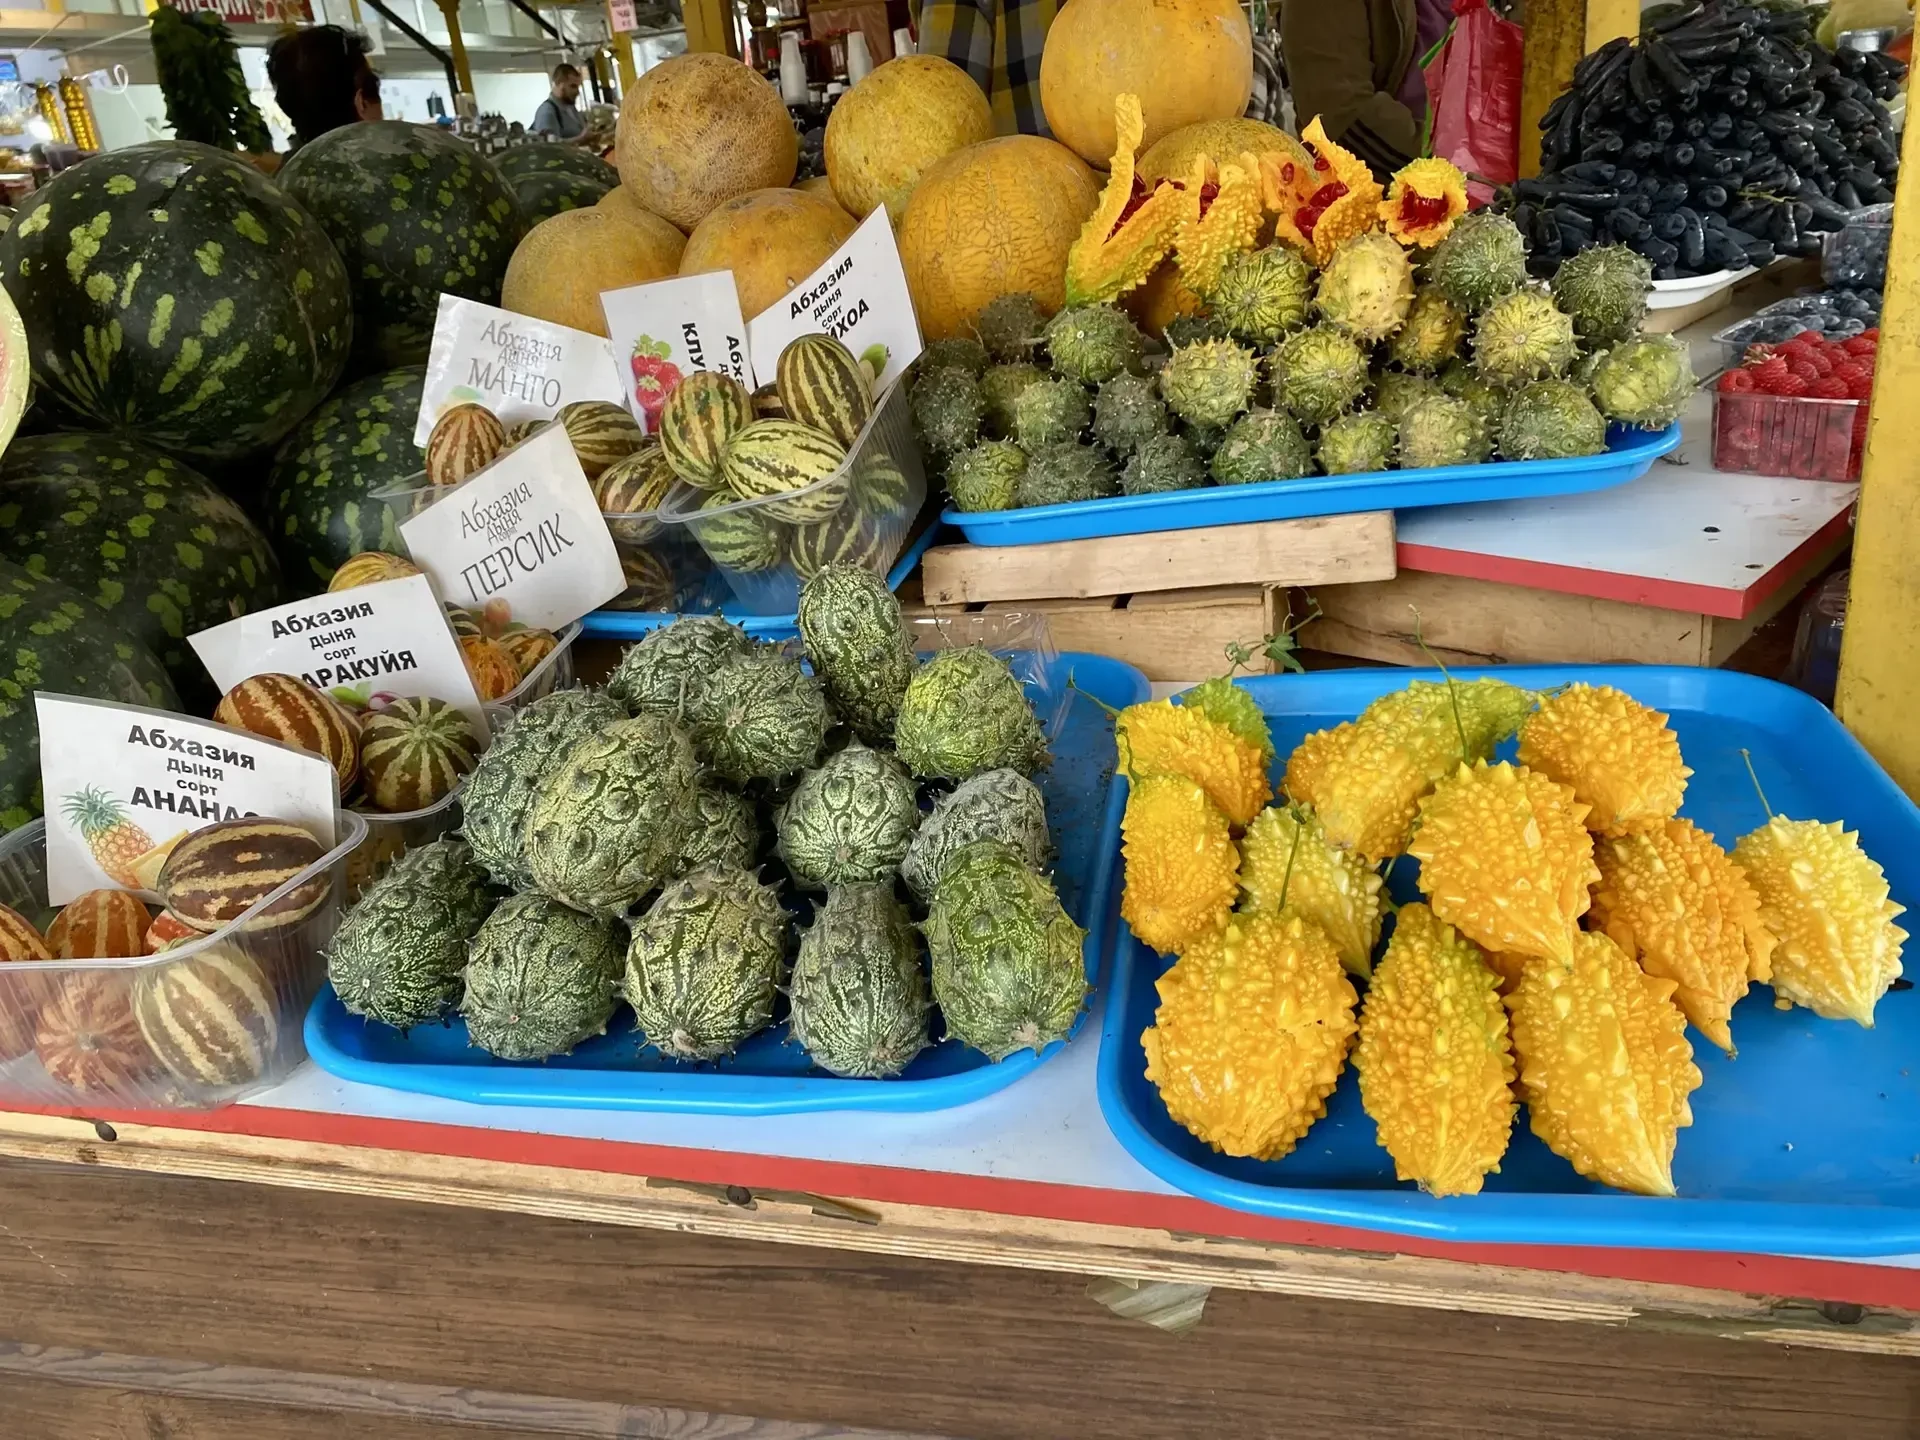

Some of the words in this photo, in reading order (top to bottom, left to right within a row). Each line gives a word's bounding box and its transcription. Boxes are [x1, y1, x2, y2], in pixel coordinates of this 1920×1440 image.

[790, 256, 853, 319] Абхазия
[813, 288, 842, 321] дыня
[822, 305, 843, 328] сорт
[824, 299, 870, 340] ЙХОА
[480, 319, 563, 362] Абхазия
[682, 322, 707, 374] КЛУ
[467, 358, 561, 408] МАНГО
[461, 482, 533, 539] Абхазия
[486, 508, 522, 546] дыня
[460, 513, 574, 602] ПЕРСИК
[271, 602, 374, 639] Абхазия
[309, 628, 356, 650] дыня
[301, 649, 418, 689] АРАКУЙЯ
[323, 645, 357, 661] сорт
[127, 724, 256, 771] Абхазия
[166, 757, 224, 781] дыня
[176, 779, 218, 797] сорт
